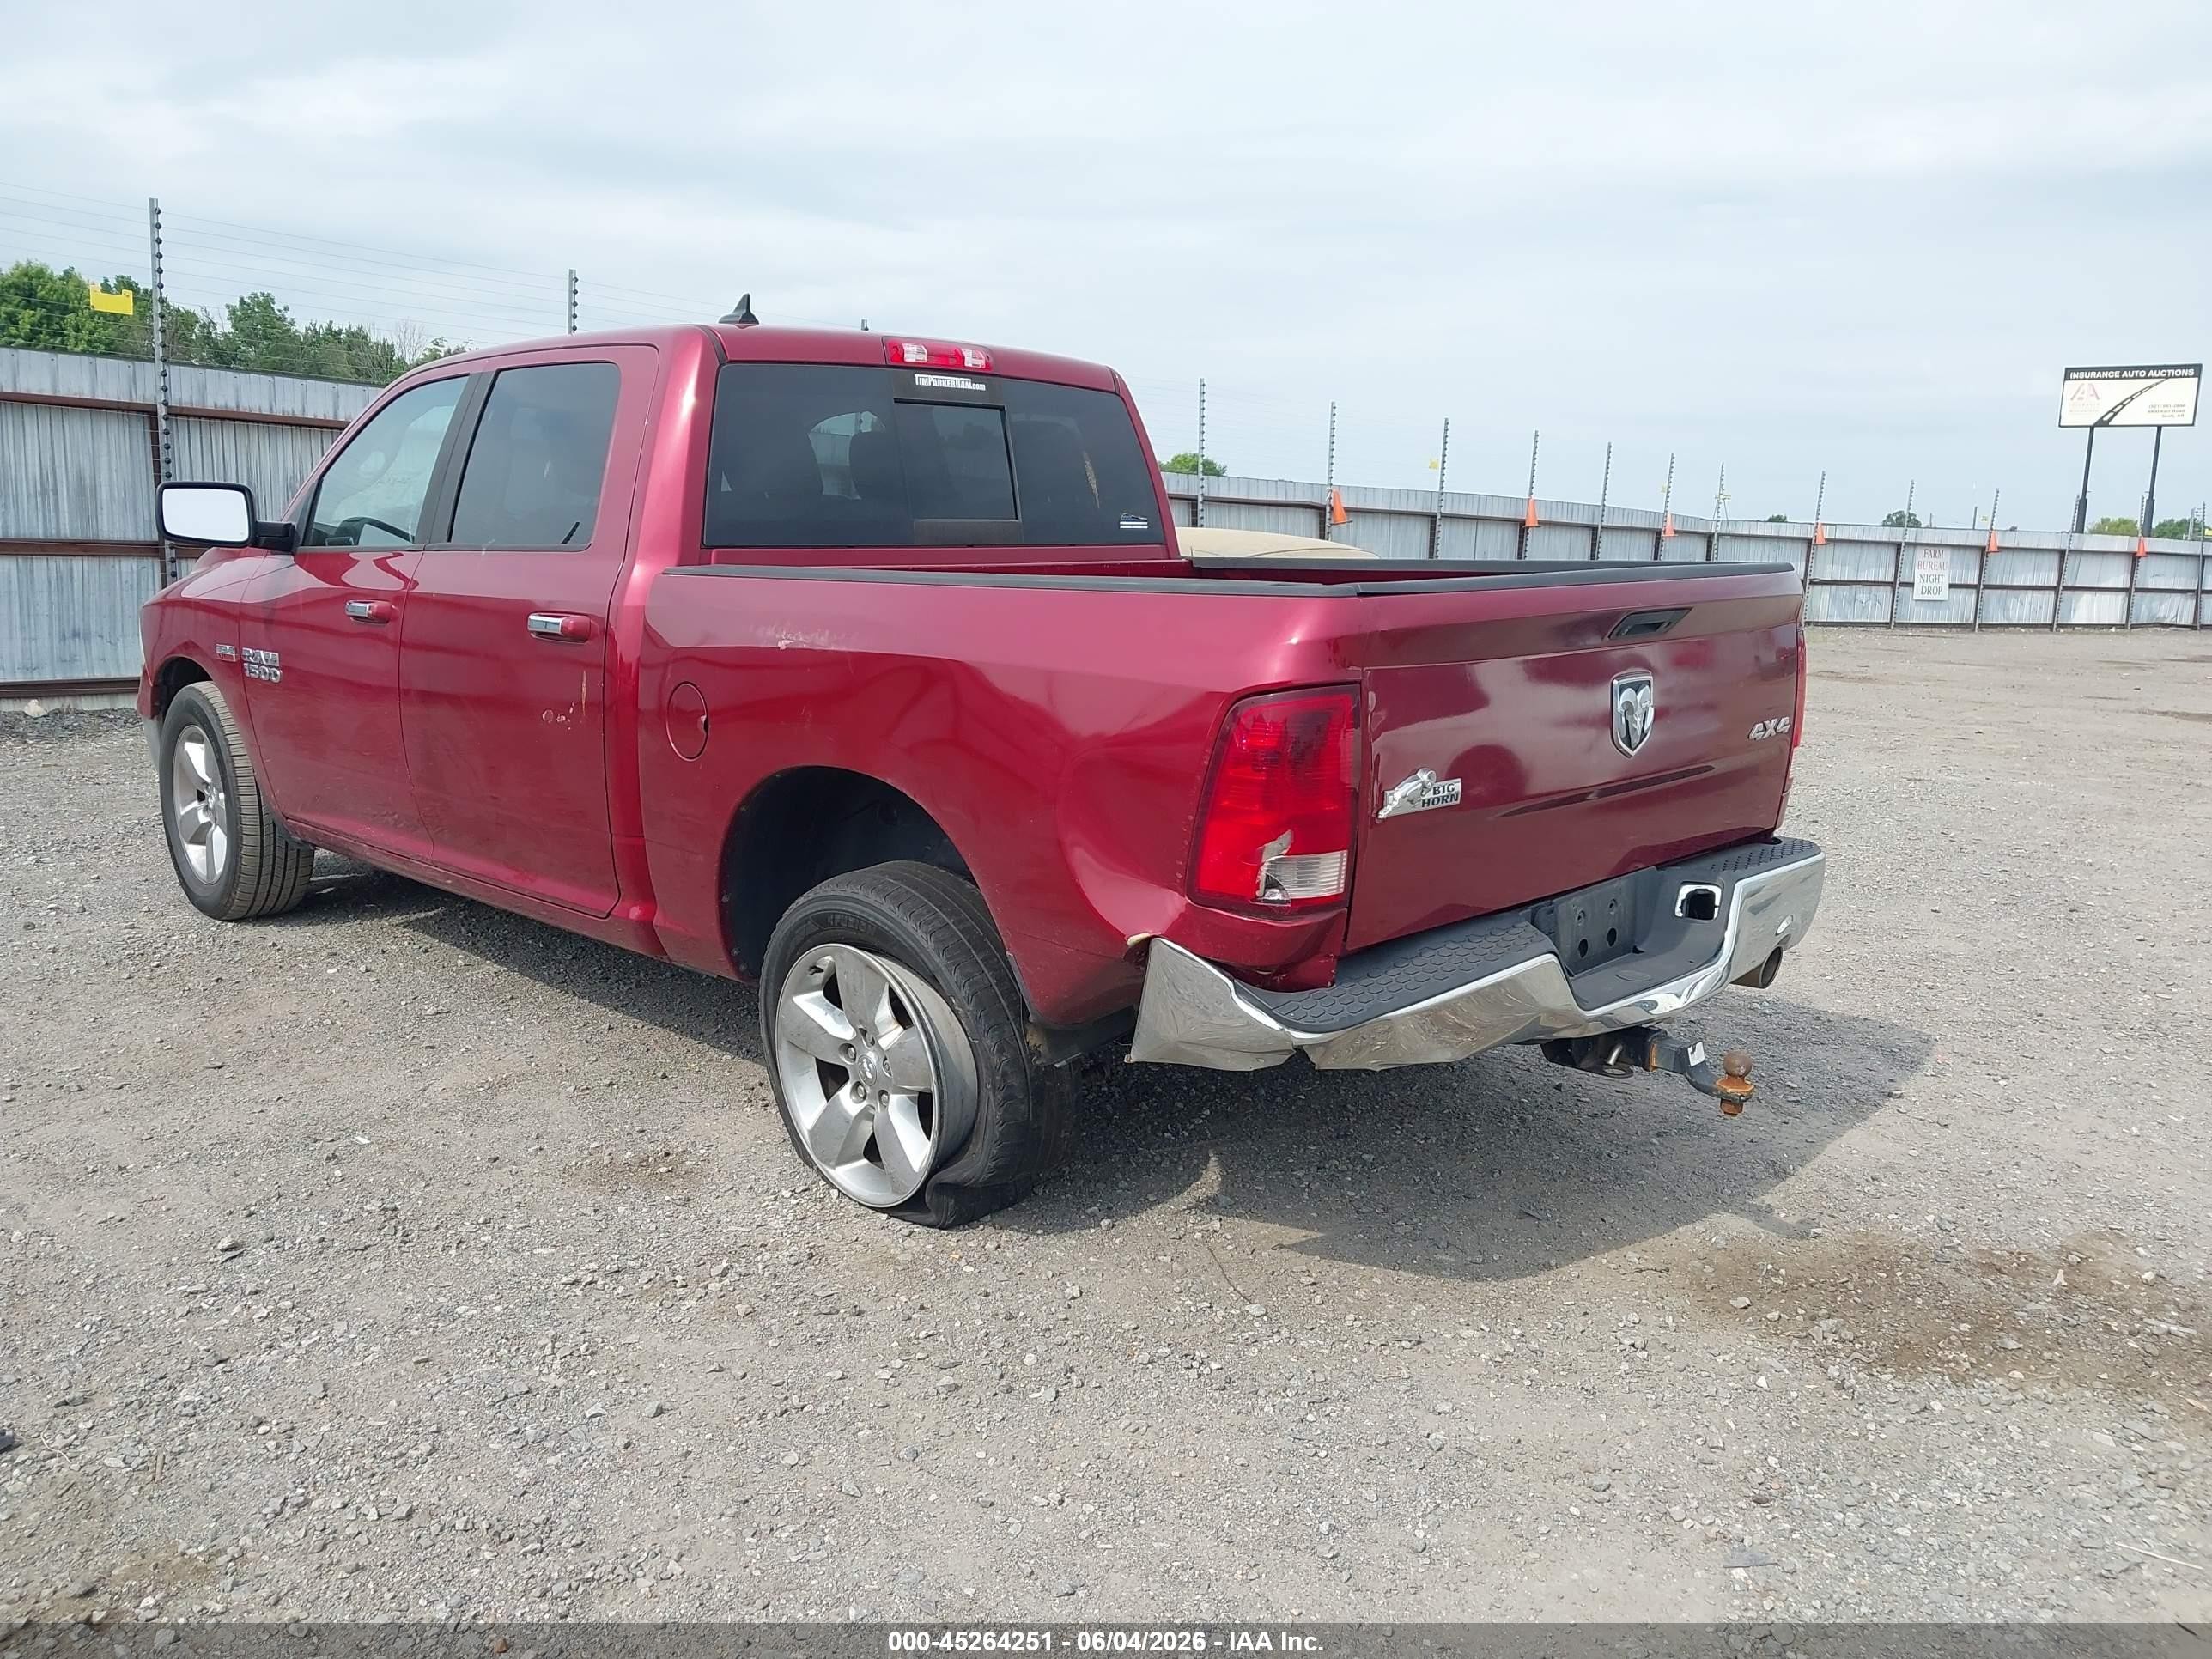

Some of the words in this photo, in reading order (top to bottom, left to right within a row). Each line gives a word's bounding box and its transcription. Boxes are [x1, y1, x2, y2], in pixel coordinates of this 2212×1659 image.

[2069, 371, 2120, 380] INSURANCE
[2122, 369, 2146, 378] AUTO
[2147, 368, 2195, 378] AUCTIONS
[1923, 549, 1944, 559] FARM
[1917, 560, 1948, 571] BUREAU
[1919, 574, 1945, 584] NIGHT
[1921, 586, 1943, 595] DROP
[242, 647, 279, 667] RAM
[243, 663, 282, 683] 1500
[1432, 783, 1455, 795] BIG
[1421, 793, 1459, 807] HORN
